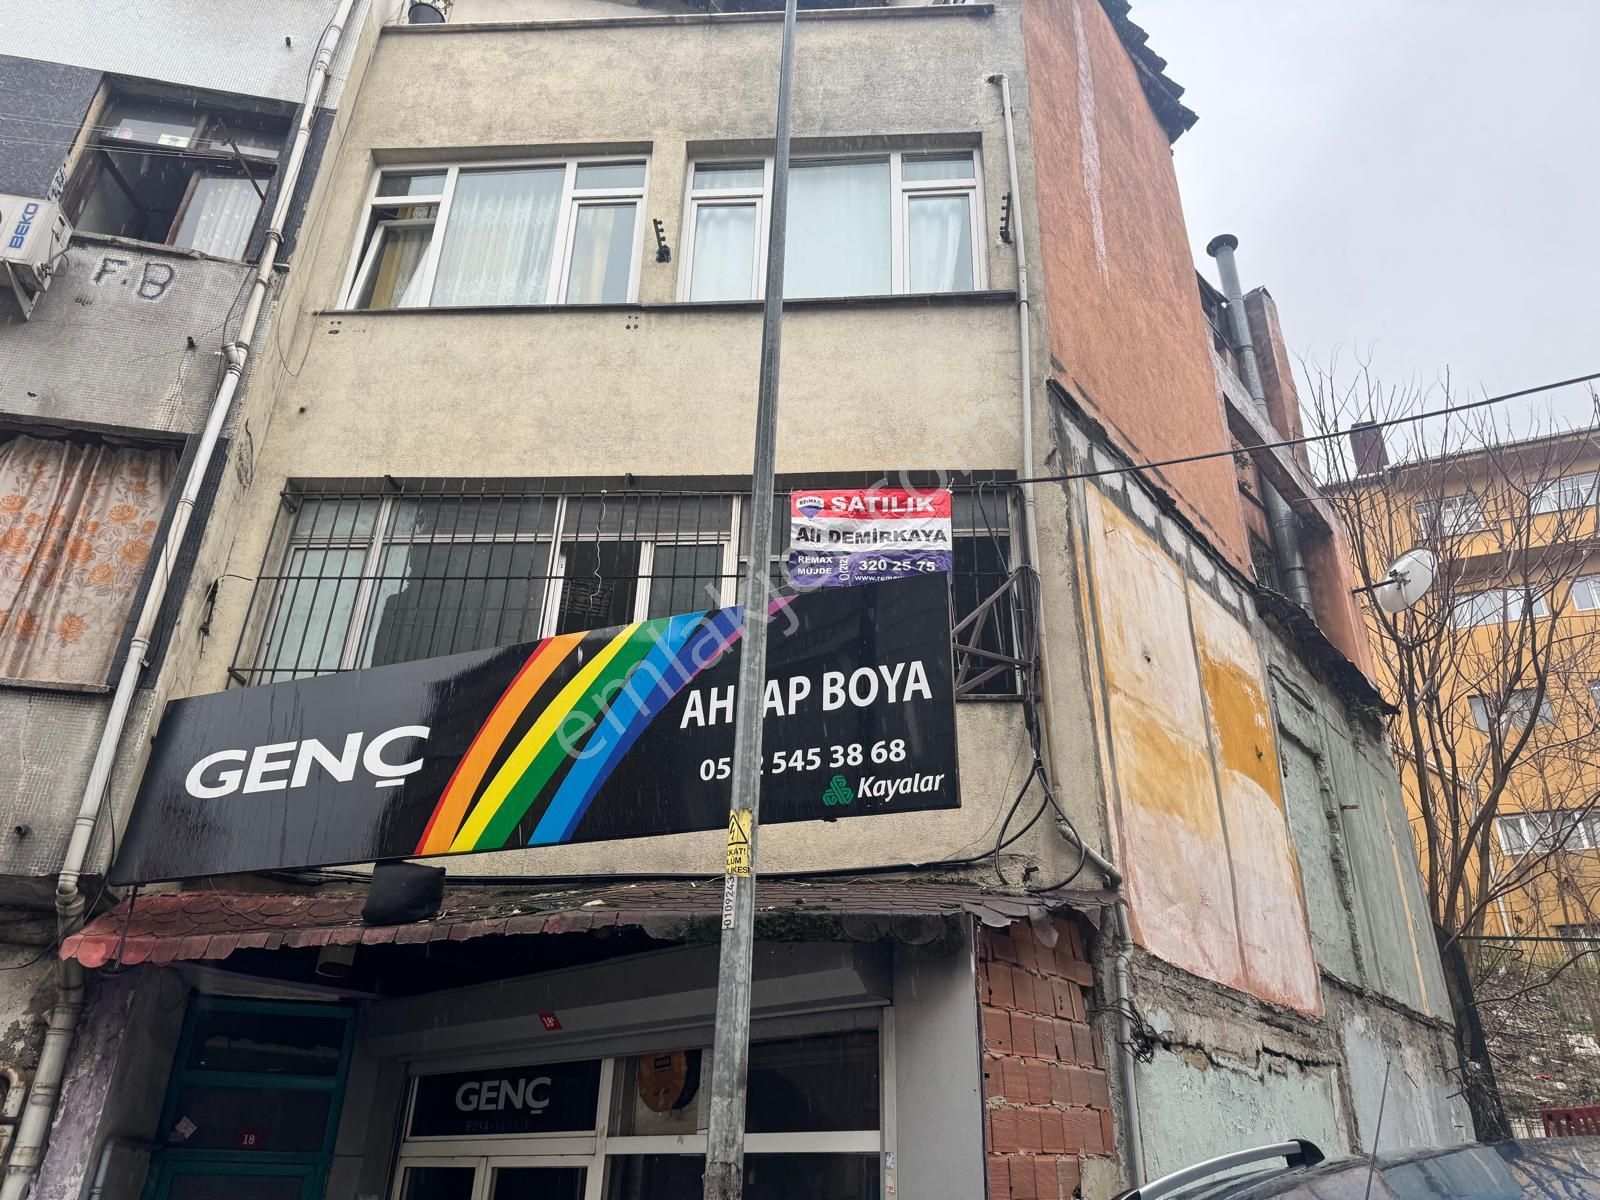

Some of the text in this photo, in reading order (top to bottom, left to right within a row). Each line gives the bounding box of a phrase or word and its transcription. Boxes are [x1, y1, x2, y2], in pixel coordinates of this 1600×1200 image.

[8, 202, 39, 249] BEKO
[830, 495, 936, 513] SATILIK
[795, 527, 948, 545] Ali DEMİRKAYA
[797, 566, 832, 576] MÜJDE
[798, 555, 833, 565] REMAX
[858, 559, 936, 572] 320 25 75
[680, 660, 933, 729] AHAP BOYA
[185, 725, 431, 799] GENÇ
[772, 748, 821, 774] 545
[829, 743, 863, 768] 38
[870, 738, 907, 764] 68
[857, 773, 945, 803] Kayalar
[723, 875, 735, 926] 0109243
[455, 1077, 552, 1115] GENÇ
[243, 1134, 255, 1145] 18
